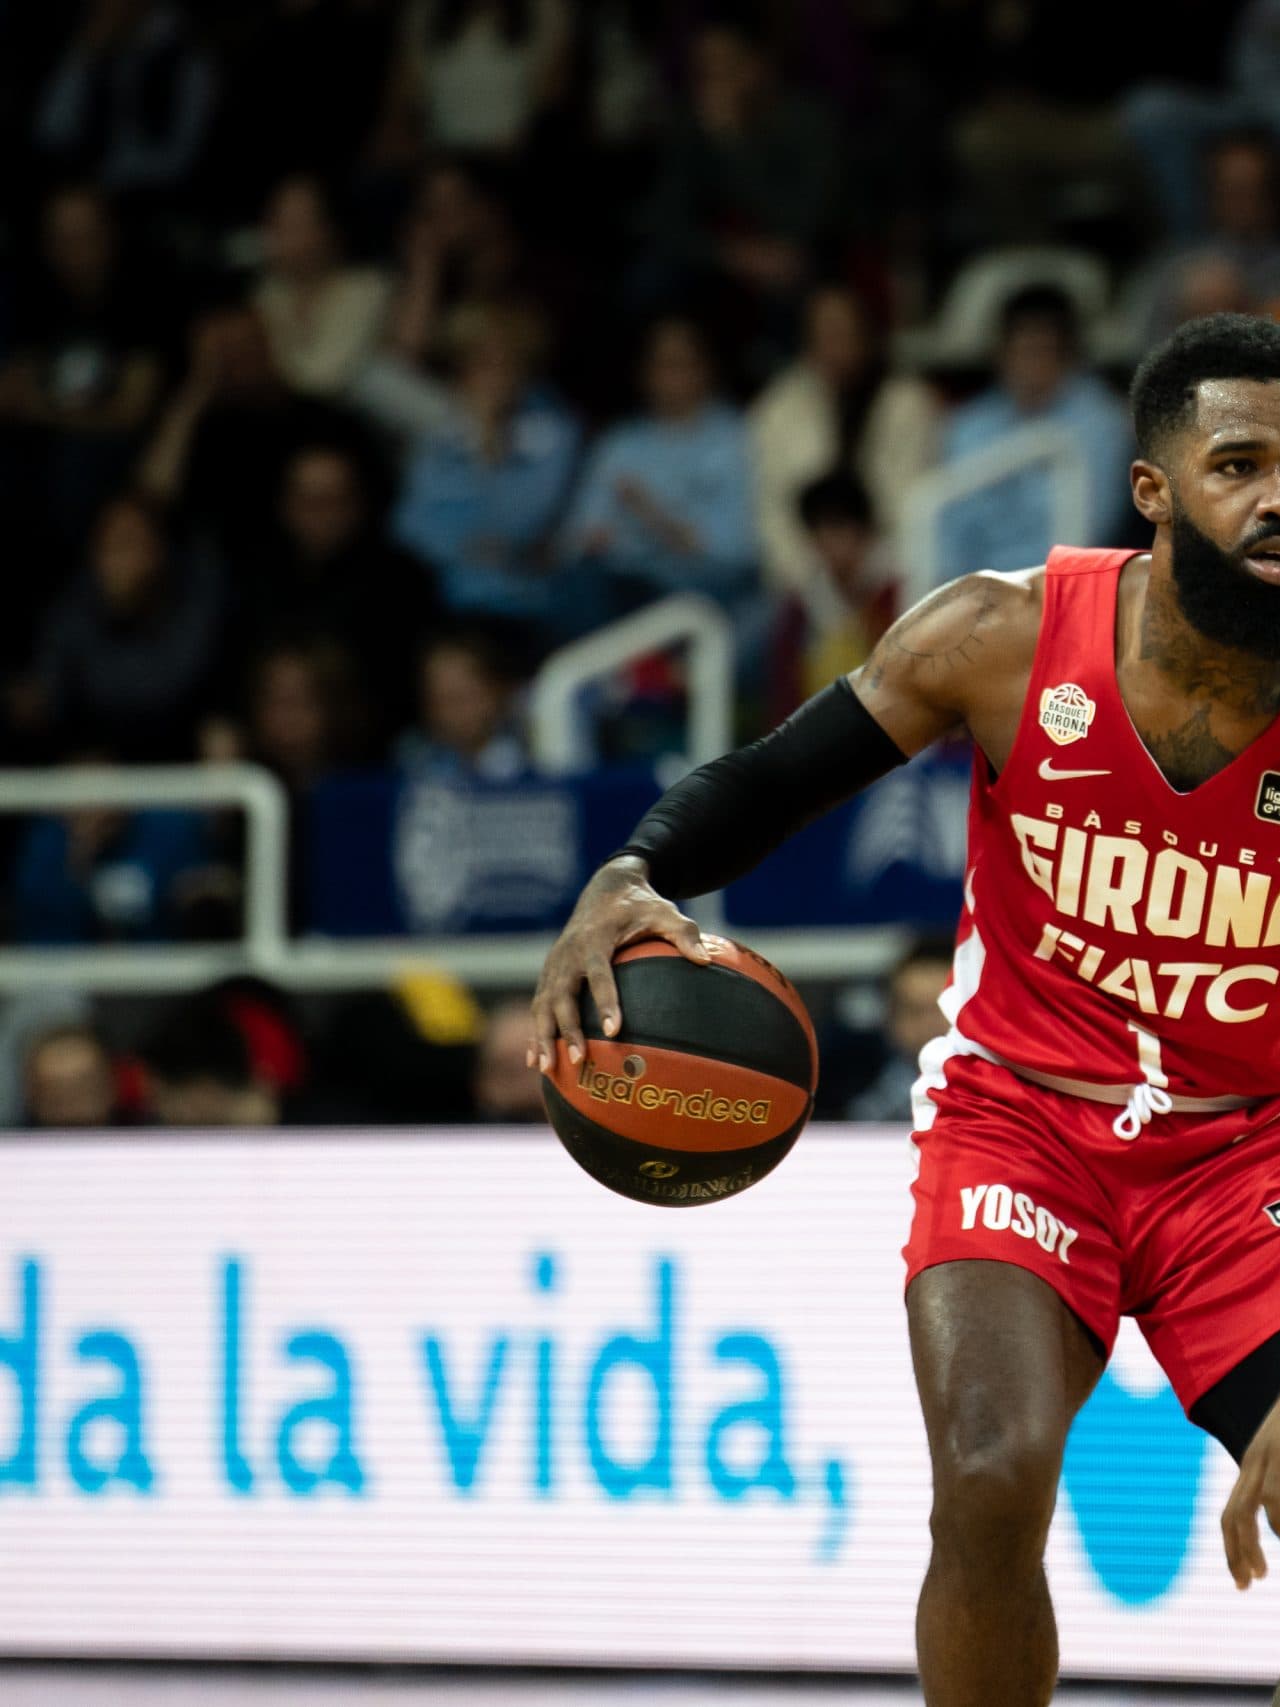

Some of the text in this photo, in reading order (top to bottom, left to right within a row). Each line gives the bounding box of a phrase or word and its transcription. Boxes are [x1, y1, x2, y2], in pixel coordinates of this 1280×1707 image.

[1042, 711, 1086, 735] GIRONA
[1033, 922, 1280, 1024] FIATC
[1127, 1019, 1169, 1089] 1
[577, 1060, 772, 1126] liga endesa
[960, 1183, 1079, 1265] YOSOY
[219, 1253, 369, 1496] la
[417, 1252, 856, 1562] vida,
